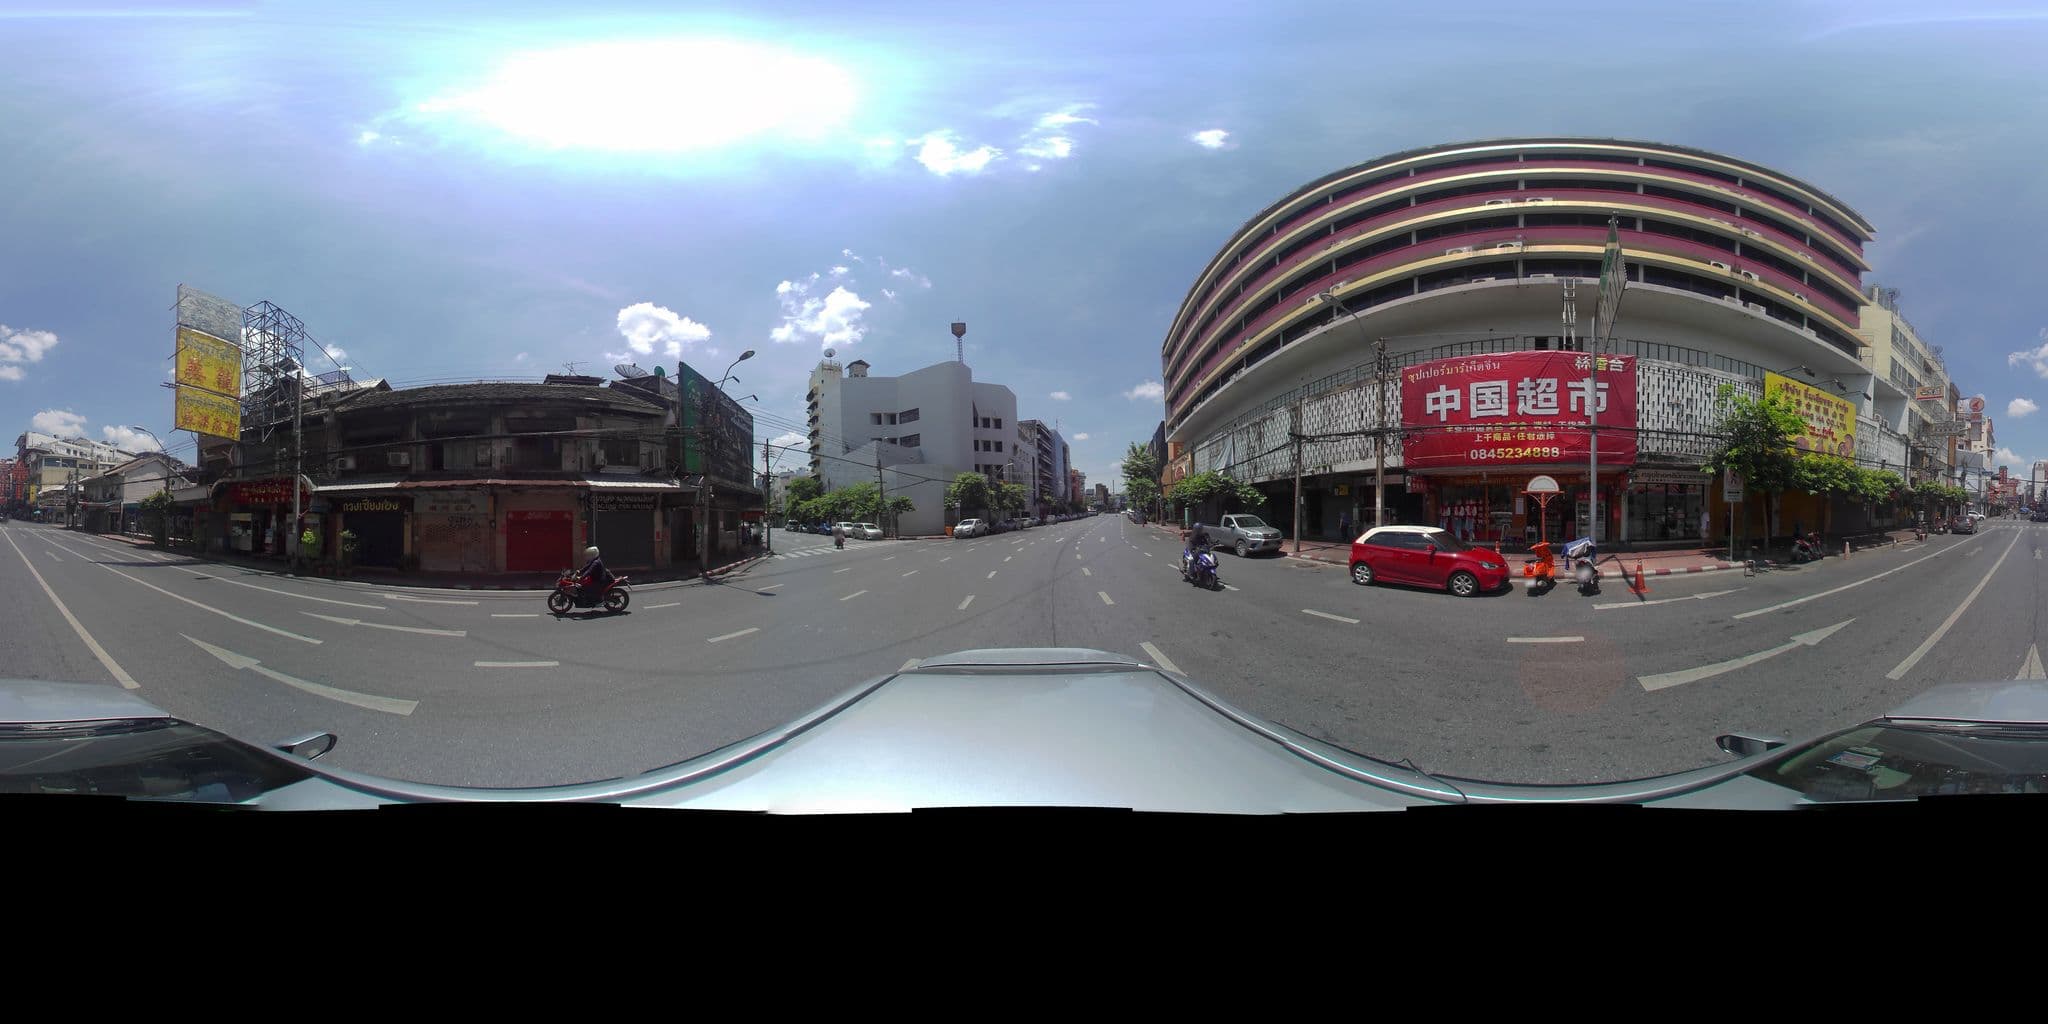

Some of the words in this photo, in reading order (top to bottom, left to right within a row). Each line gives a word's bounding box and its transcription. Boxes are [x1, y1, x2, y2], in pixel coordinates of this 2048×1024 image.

[1426, 376, 1609, 422] 中国超市
[1470, 447, 1560, 460] 0845234888
